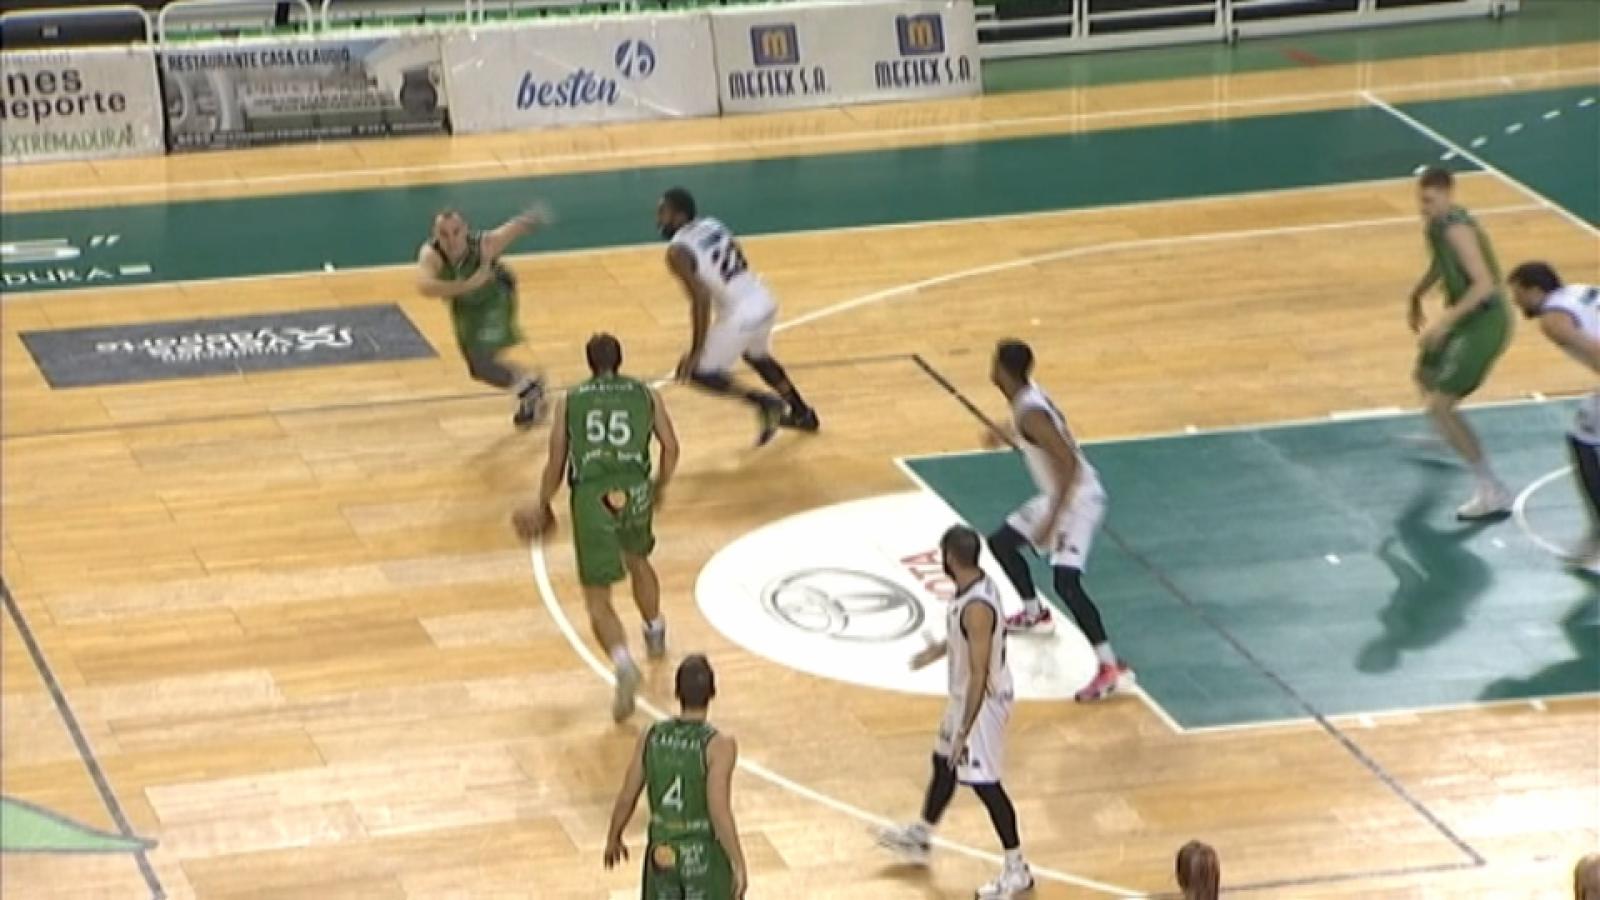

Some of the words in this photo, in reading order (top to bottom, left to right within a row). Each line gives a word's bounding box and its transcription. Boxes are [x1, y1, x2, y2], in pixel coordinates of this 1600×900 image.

[168, 53, 257, 72] RESTAURANTE
[261, 49, 295, 66] CASA
[0, 126, 132, 156] XTREMADURA
[661, 775, 683, 813] 4
